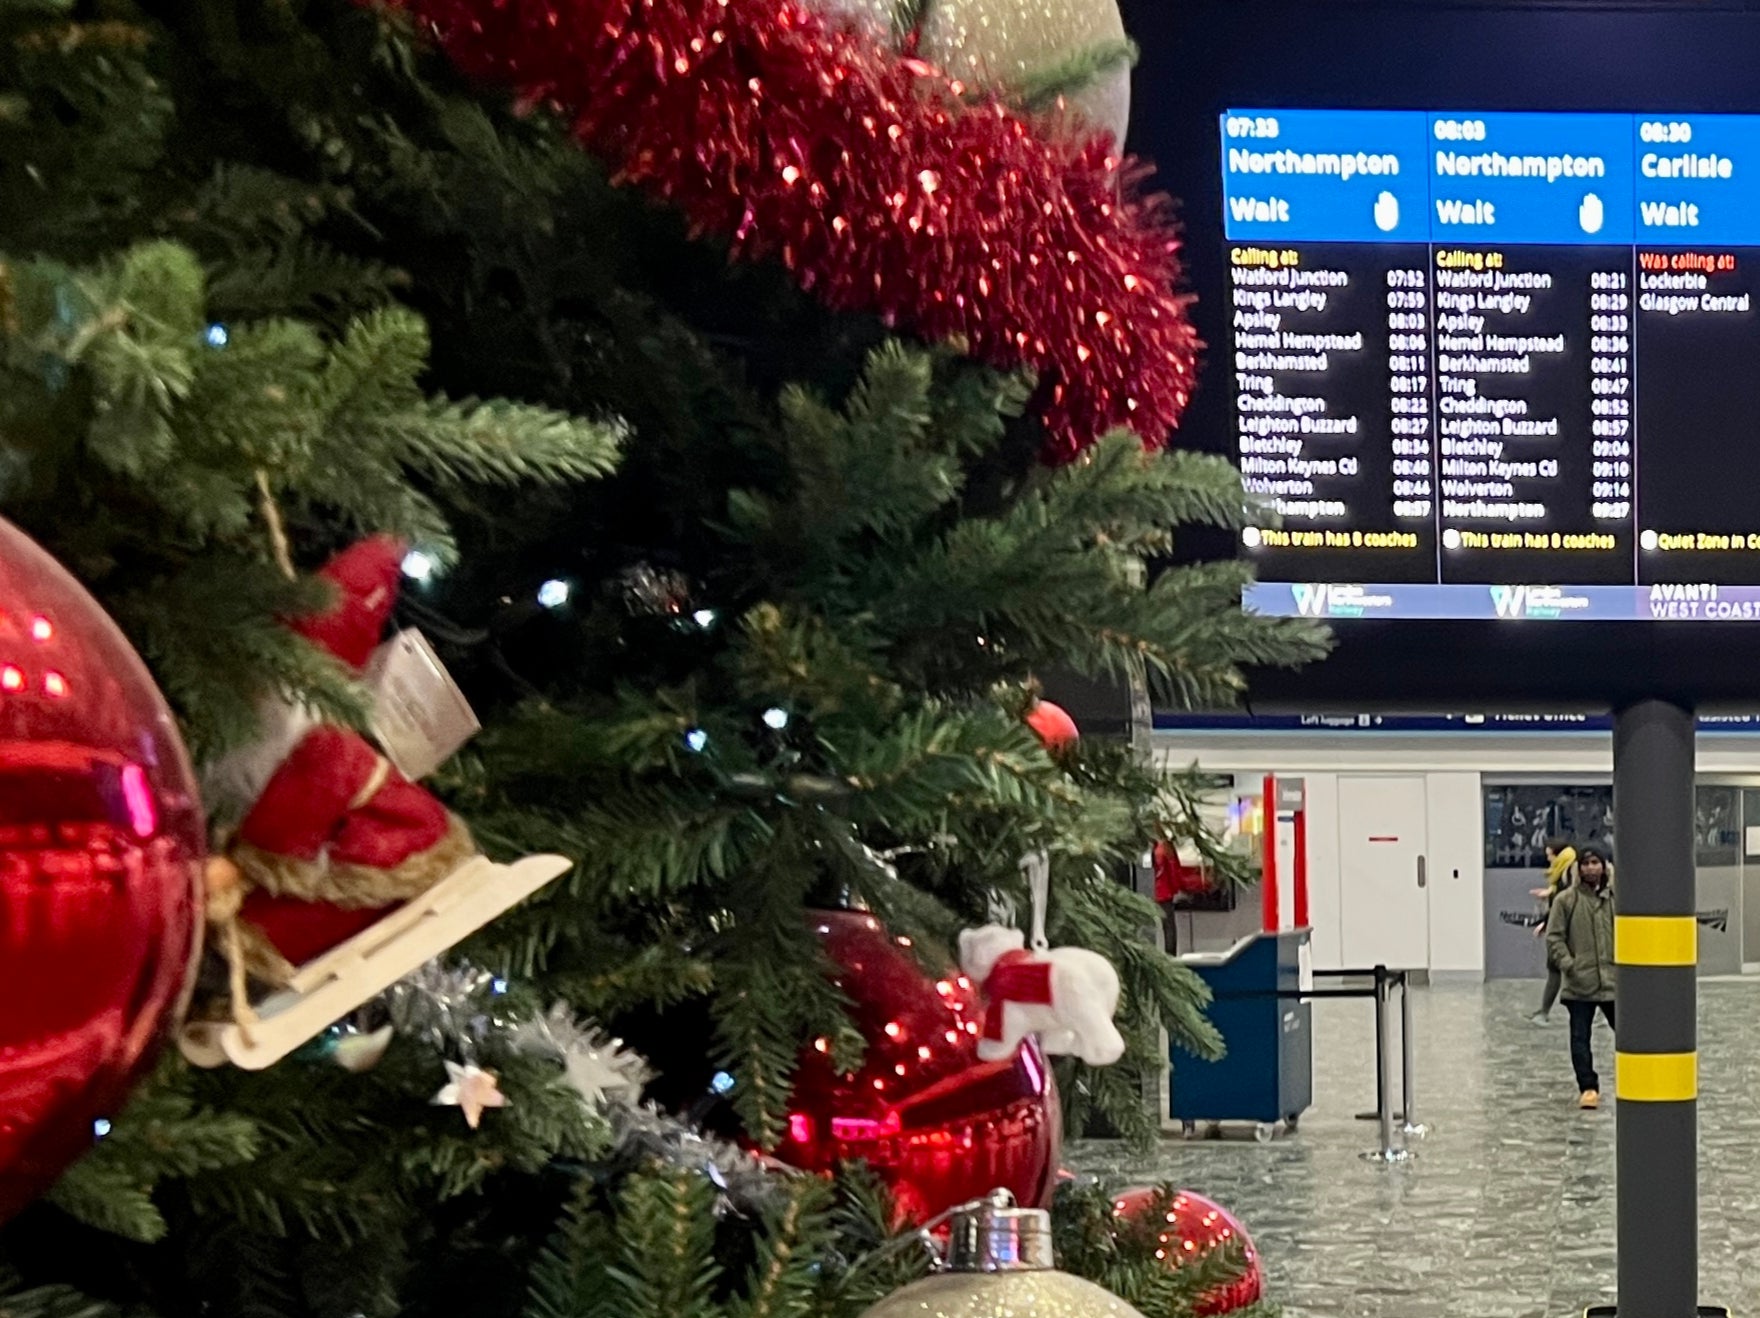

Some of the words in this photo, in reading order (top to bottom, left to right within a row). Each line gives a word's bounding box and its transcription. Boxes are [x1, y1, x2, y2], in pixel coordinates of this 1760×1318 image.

[1228, 148, 1400, 181] Northampton
[1436, 150, 1605, 183] Northampton
[1641, 153, 1733, 179] Carlisle
[1229, 196, 1290, 222] Wait
[1435, 199, 1495, 225] Wait
[1640, 201, 1699, 227] Wait
[1230, 247, 1279, 270] Calling
[1279, 249, 1299, 266] at:
[1436, 249, 1484, 272] Calling
[1484, 252, 1503, 272] at:
[1639, 253, 1669, 275] Was
[1670, 252, 1716, 275] calling
[1716, 254, 1735, 270] at:
[1231, 266, 1290, 286] Watford
[1289, 267, 1349, 289] Junction
[1640, 270, 1708, 290] Lockerbie
[1232, 288, 1272, 313] Kings
[1273, 289, 1327, 312] Langley
[1639, 292, 1699, 316] Glasgow
[1700, 293, 1750, 312] Central
[1233, 310, 1282, 334] Apsley
[1234, 331, 1281, 349] Hemel
[1282, 331, 1363, 354] Hempstead
[1235, 352, 1329, 371] Berkhamsted
[1235, 372, 1275, 394] Tring
[1237, 392, 1326, 417] Cheddington
[1238, 414, 1300, 437] Leighton
[1300, 415, 1358, 434] Buzzard
[1239, 435, 1303, 458] Bletchley
[1239, 458, 1287, 475] Milton
[1287, 457, 1338, 479] Keynes
[1260, 529, 1291, 548] This
[1291, 529, 1323, 548] train
[1325, 530, 1351, 548] has
[1364, 530, 1418, 549] coaches
[1656, 533, 1696, 551] Quiet
[1696, 532, 1730, 550] Zone
[1730, 534, 1746, 549] in
[1649, 583, 1717, 601] AVANTI
[1650, 601, 1699, 619] WEST
